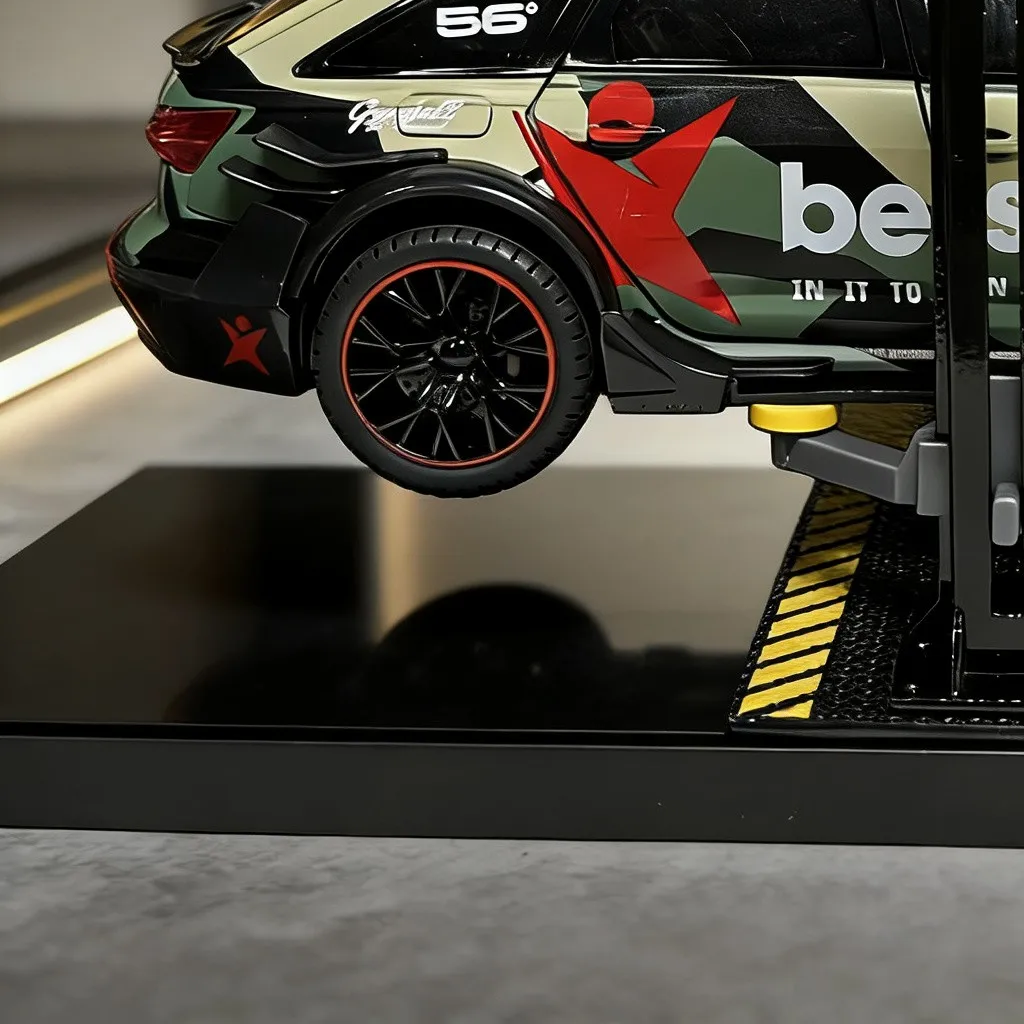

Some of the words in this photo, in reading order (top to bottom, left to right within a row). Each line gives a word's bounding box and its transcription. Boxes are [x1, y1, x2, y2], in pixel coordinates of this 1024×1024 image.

[791, 279, 825, 301] IN
[844, 280, 869, 303] IT
[889, 281, 923, 304] TO
